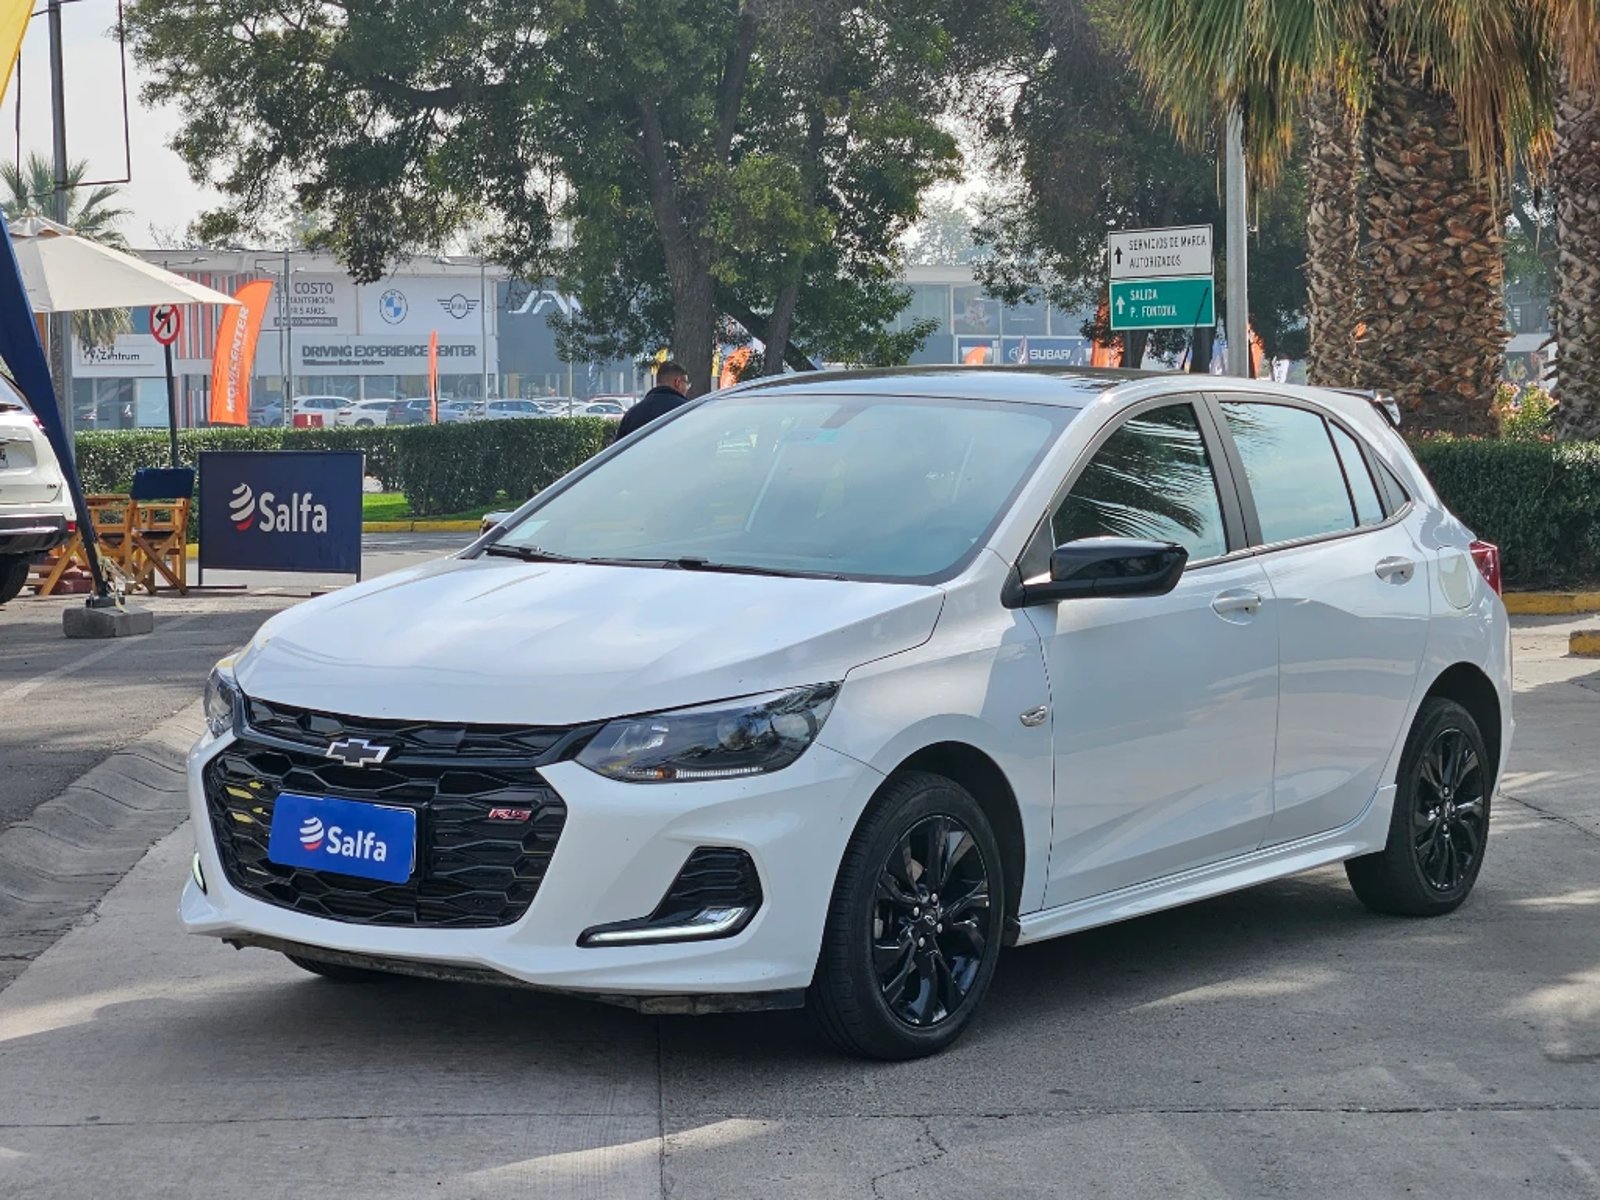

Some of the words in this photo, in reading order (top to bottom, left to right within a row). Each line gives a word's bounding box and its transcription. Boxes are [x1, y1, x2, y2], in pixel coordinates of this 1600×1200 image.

[1169, 237, 1179, 248] DE
[1181, 235, 1207, 248] MARCA
[1129, 254, 1182, 269] AUTORIZADOS
[294, 282, 334, 295] COSTO
[1130, 288, 1158, 301] SALIDA
[302, 345, 352, 357] DRIVING
[354, 345, 430, 357] EXPERIENCE
[259, 491, 328, 533] Salfa
[488, 807, 532, 821] RS
[326, 826, 387, 862] Salfa
